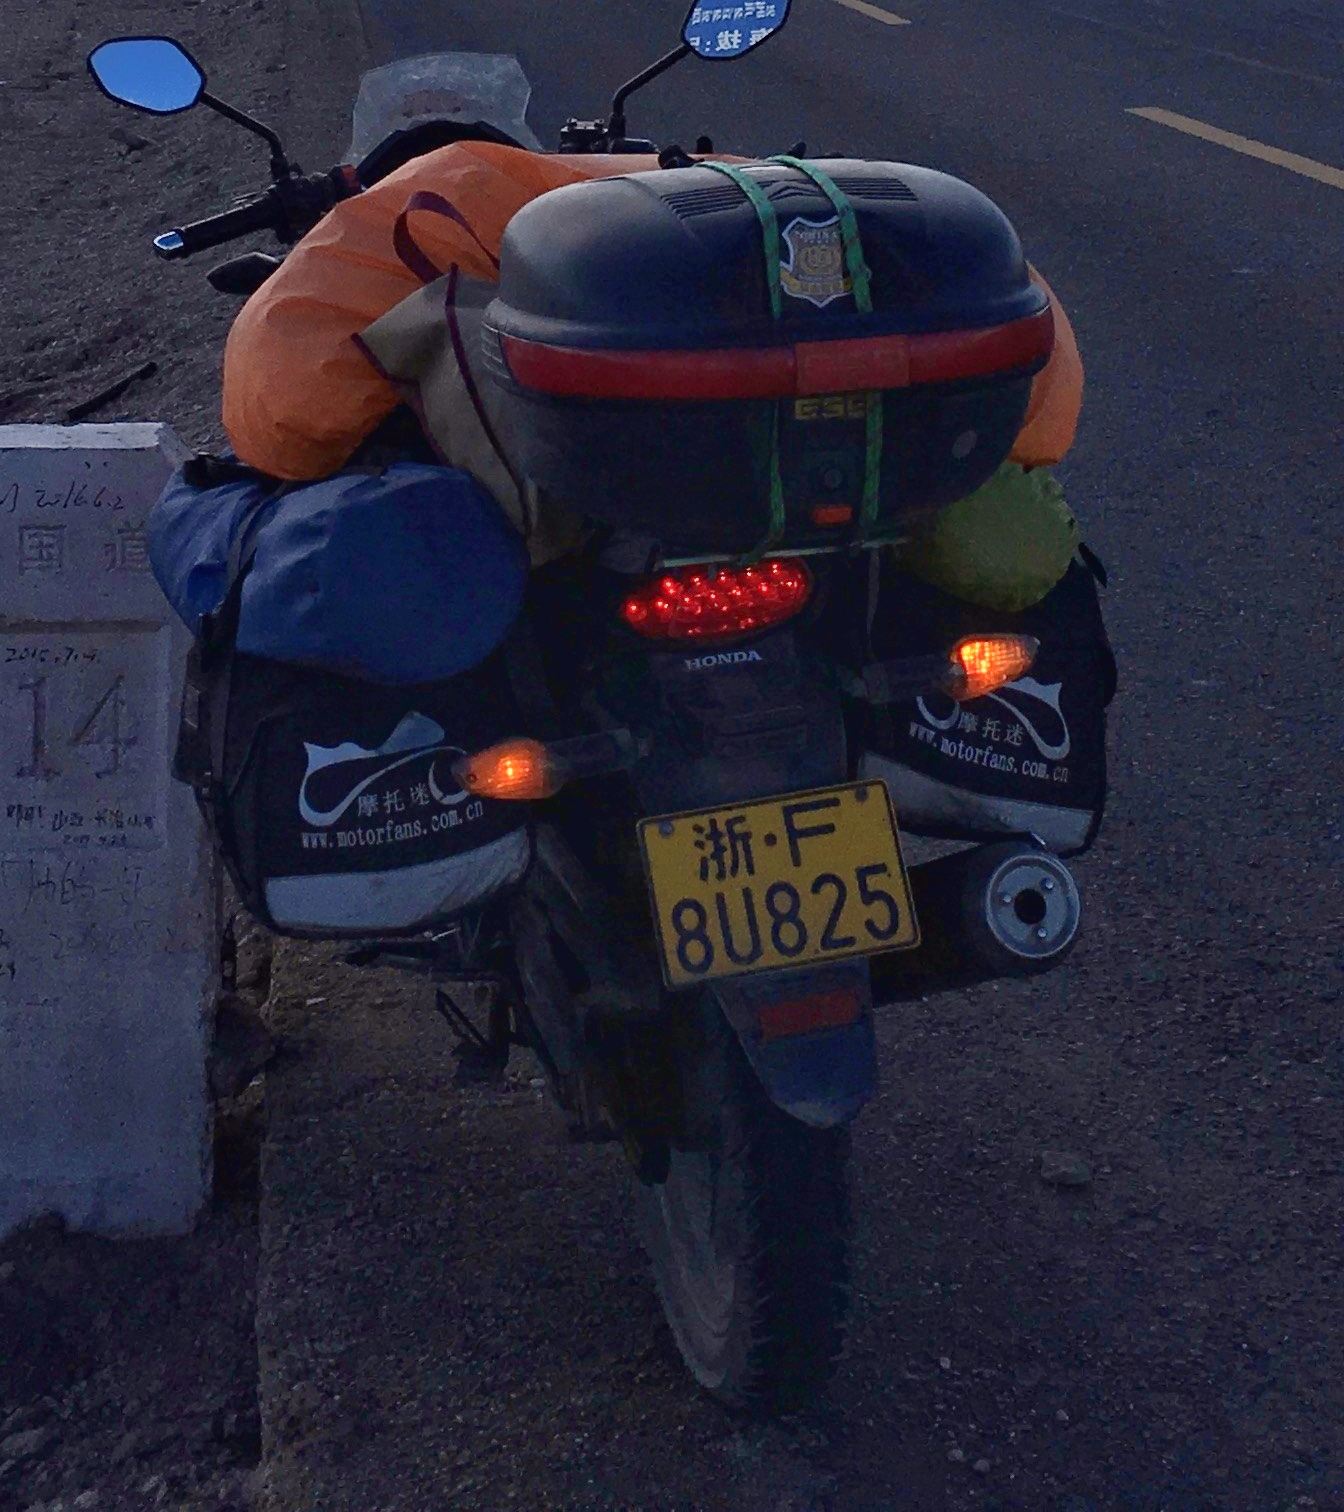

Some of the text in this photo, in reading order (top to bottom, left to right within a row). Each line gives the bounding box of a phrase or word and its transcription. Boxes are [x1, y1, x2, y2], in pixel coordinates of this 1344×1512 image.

[684, 649, 763, 671] HONDA
[909, 721, 1069, 783] www.motorfans.com.cn
[957, 711, 1024, 746] 摩托迷
[357, 782, 431, 817] 摩托迷
[301, 800, 484, 849] www.motorfans.com.cn
[692, 797, 841, 882] 浙·F
[670, 863, 900, 975] 8U825
